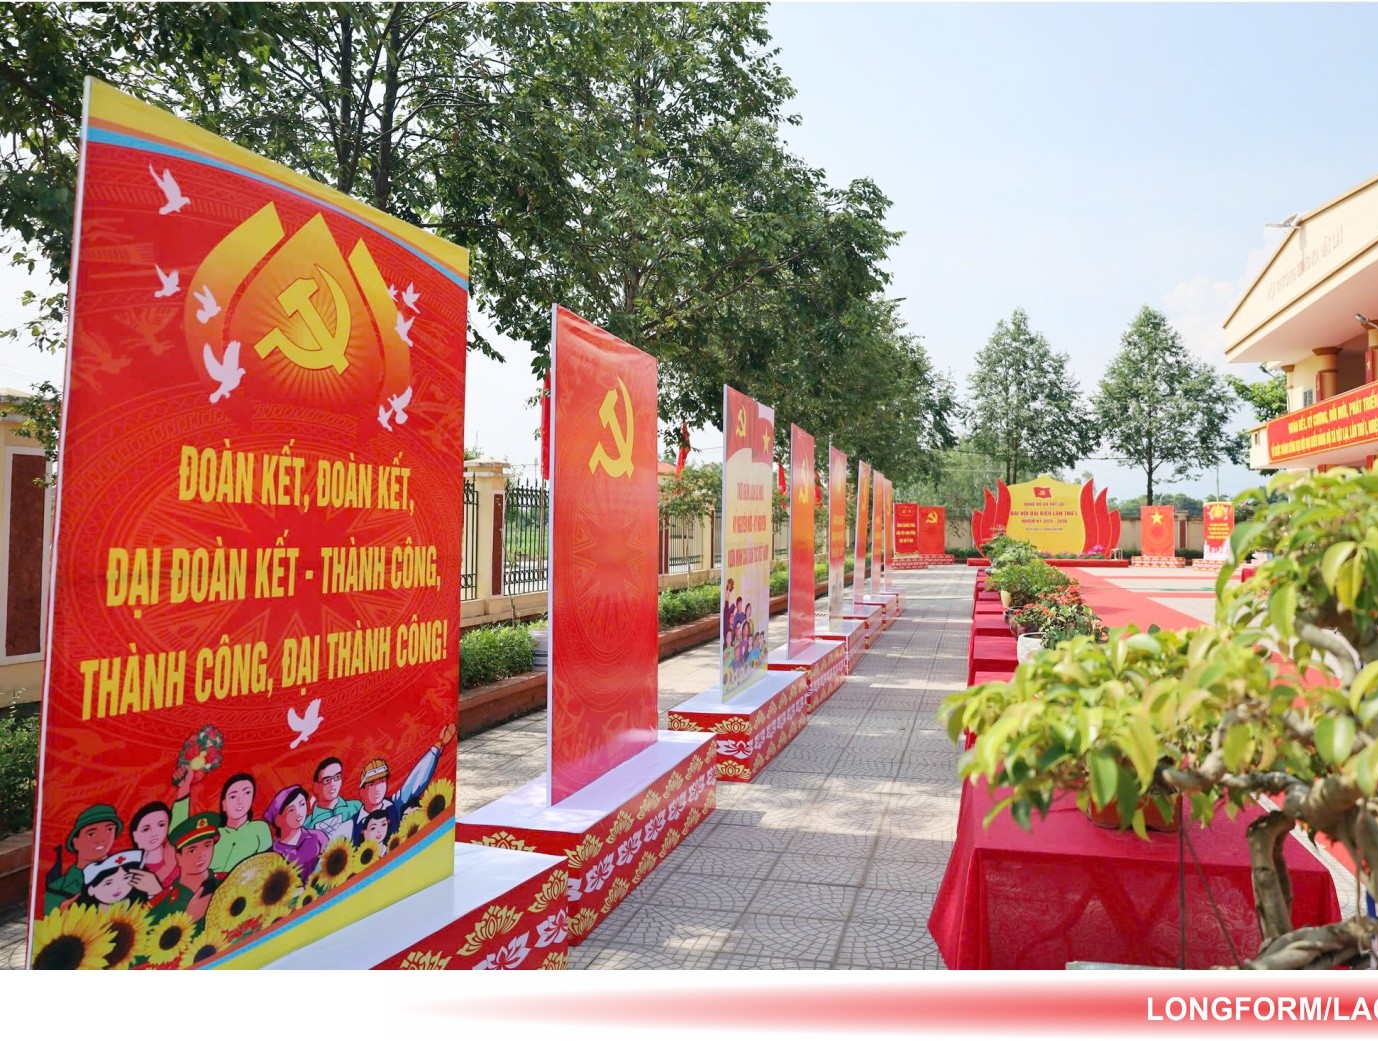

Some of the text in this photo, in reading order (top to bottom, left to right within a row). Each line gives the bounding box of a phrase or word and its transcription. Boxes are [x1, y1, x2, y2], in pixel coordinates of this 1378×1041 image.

[178, 439, 414, 515] ĐOÀN KẾT, ĐOÀN KẾT,
[106, 548, 160, 619] ĐẠI
[170, 537, 247, 603] ĐOÀN
[255, 529, 299, 599] KẾT
[321, 537, 385, 594] THÀNH
[391, 536, 441, 592] CÔNG,
[80, 614, 448, 721] THÀNH CÔNG, ĐẠI THÀNH CÔNG!
